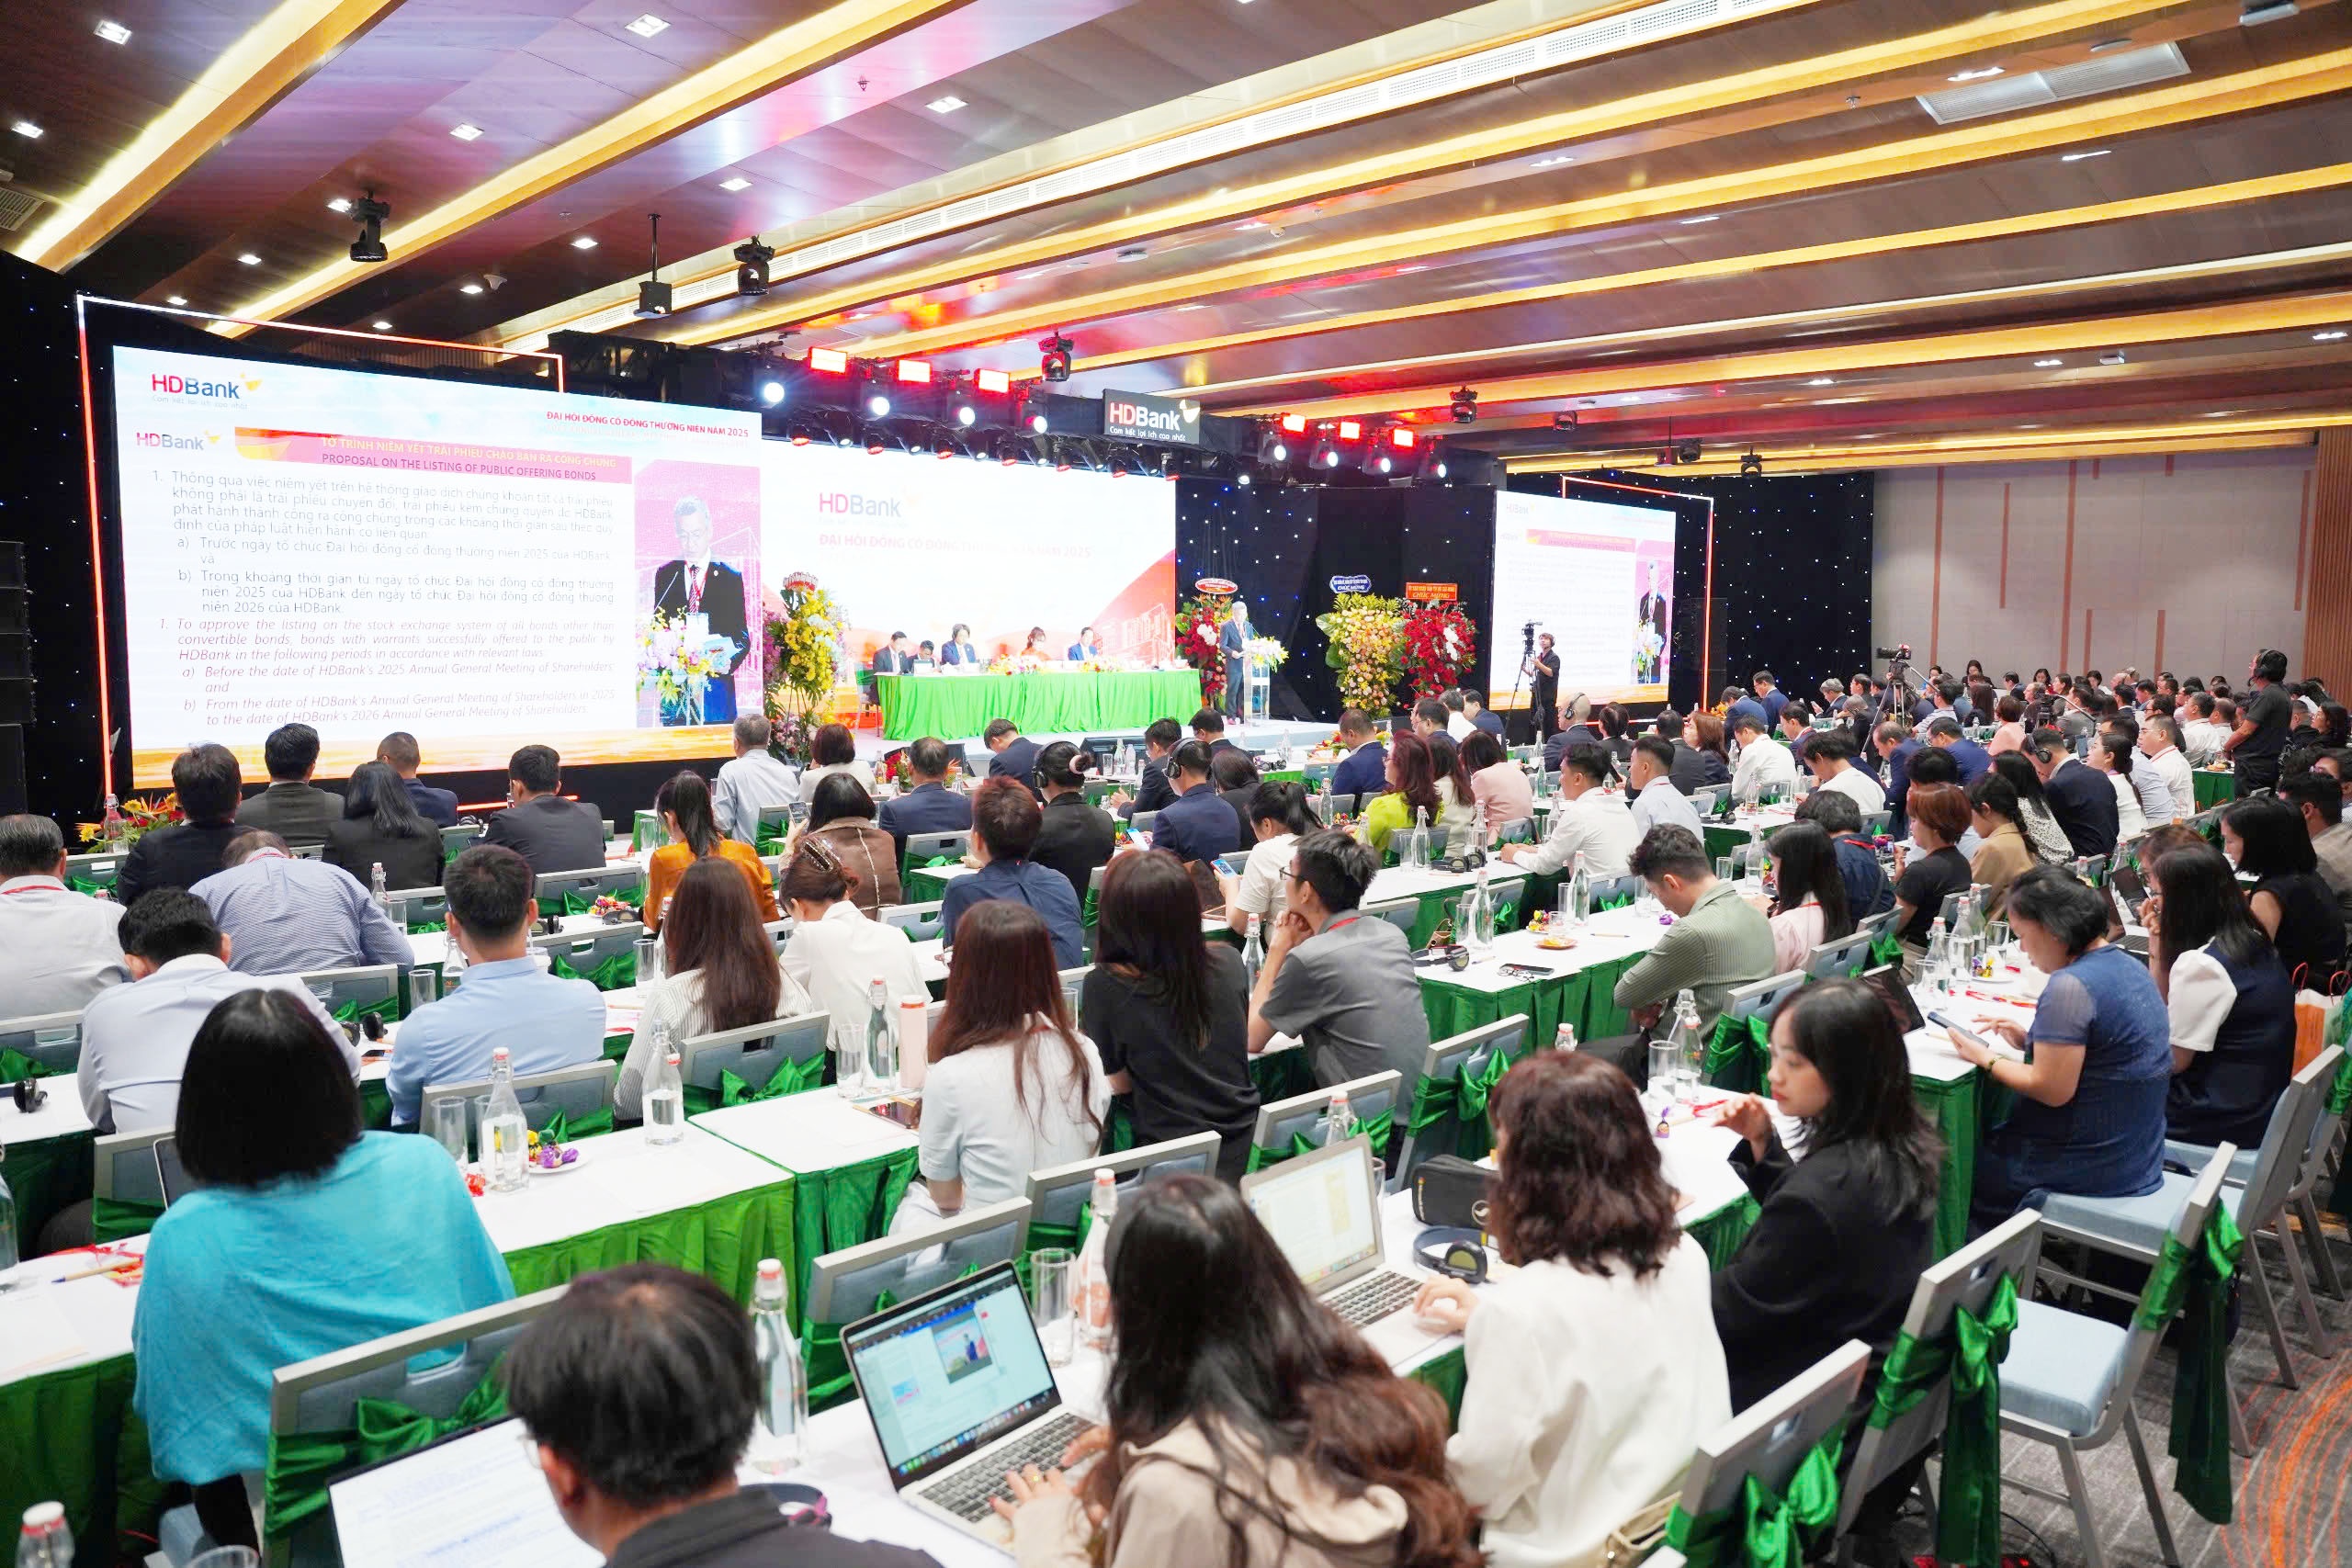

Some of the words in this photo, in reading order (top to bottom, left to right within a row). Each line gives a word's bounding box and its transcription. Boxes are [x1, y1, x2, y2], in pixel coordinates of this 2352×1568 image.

[151, 373, 240, 399] HDBank
[1109, 402, 1181, 431] HDBank
[728, 428, 749, 437] 2025
[136, 432, 204, 450] HDBank
[322, 453, 378, 466] PROPOSAL
[381, 457, 398, 468] ON
[401, 458, 421, 468] THE
[424, 460, 462, 471] LISTING
[465, 463, 477, 472] OF
[481, 464, 514, 475] PUBLIC
[516, 467, 561, 479] OFFERING
[564, 470, 596, 480] BONDS
[219, 477, 243, 489] qua
[819, 492, 902, 518] HDBank
[177, 536, 189, 549] a)
[178, 569, 192, 582] b)
[201, 570, 239, 584] Trong
[327, 573, 352, 586] gian
[235, 586, 266, 597] 2025
[299, 587, 345, 598] HDBank
[233, 602, 264, 612] 2026
[177, 618, 191, 629] To
[199, 621, 250, 632] approve
[256, 618, 276, 629] the
[282, 618, 317, 632] listing
[344, 619, 362, 629] the
[368, 619, 395, 630] stock
[401, 619, 451, 633] exchange
[456, 621, 492, 633] system
[496, 620, 508, 633] of
[512, 620, 524, 630] all
[529, 620, 559, 630] bonds
[563, 620, 589, 630] other
[593, 620, 615, 630] than
[178, 633, 247, 644] convertible
[300, 633, 335, 644] bonds
[342, 633, 366, 644] with
[373, 635, 420, 644] warrants
[426, 633, 487, 647] successfully
[492, 633, 527, 646] offered
[533, 634, 543, 643] to
[548, 633, 564, 643] the
[569, 633, 596, 645] public
[603, 633, 615, 645] by
[179, 649, 231, 660] HDBank
[235, 649, 247, 660] in
[252, 649, 270, 660] the
[274, 648, 327, 662] following
[331, 648, 372, 661] periods
[376, 648, 386, 659] in
[390, 647, 449, 658] accordance
[453, 647, 475, 658] with
[479, 647, 518, 657] relevant
[182, 666, 195, 679] a)
[205, 665, 243, 680] Before
[249, 665, 268, 676] the
[273, 665, 299, 676] date
[302, 664, 314, 678] of
[319, 664, 373, 675] HDBank's
[377, 664, 405, 674] 2025
[409, 663, 448, 674] Annual
[451, 662, 492, 673] General
[496, 662, 535, 675] Meeting
[538, 661, 549, 674] of
[205, 682, 230, 693] and
[184, 698, 197, 712] b)
[206, 698, 238, 709] From
[243, 697, 262, 708] the
[266, 696, 292, 707] date
[296, 696, 308, 710] of
[311, 694, 367, 706] HDBank's
[370, 694, 409, 705] Annual
[413, 693, 454, 704] General
[458, 693, 498, 705] Meeting
[501, 692, 513, 705] of
[514, 690, 576, 701] Shareholders
[580, 690, 588, 699] in
[592, 689, 616, 699] 2025
[207, 715, 219, 725] to
[223, 713, 243, 724] the
[246, 712, 272, 724] date
[277, 711, 289, 726] of
[293, 710, 347, 722] HDBank's
[351, 710, 379, 720] 2026
[382, 708, 422, 719] Annual
[424, 706, 465, 718] General
[469, 705, 509, 719] Meeting
[512, 705, 523, 717] of
